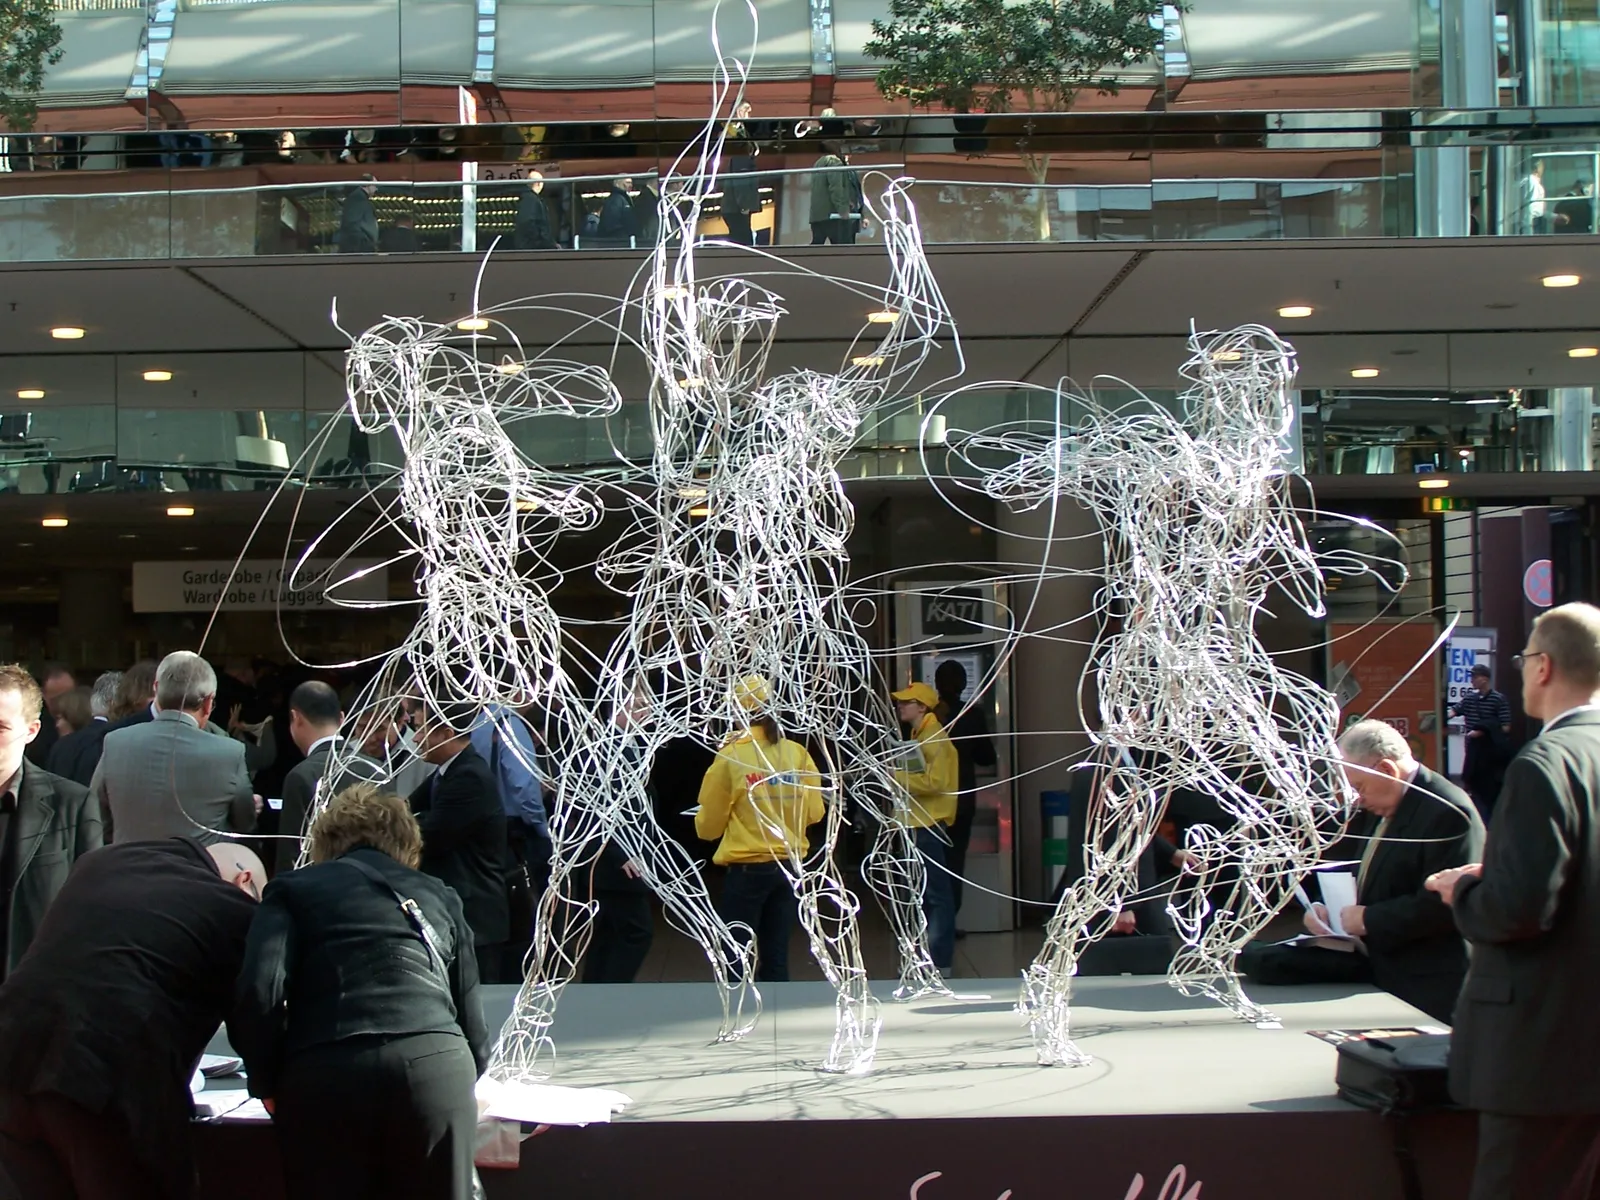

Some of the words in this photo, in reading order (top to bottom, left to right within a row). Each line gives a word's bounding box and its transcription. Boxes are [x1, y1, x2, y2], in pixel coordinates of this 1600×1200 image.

[182, 568, 262, 585] Gardeobe
[267, 569, 272, 584] /
[261, 588, 267, 603] /
[270, 589, 333, 606] Luggag
